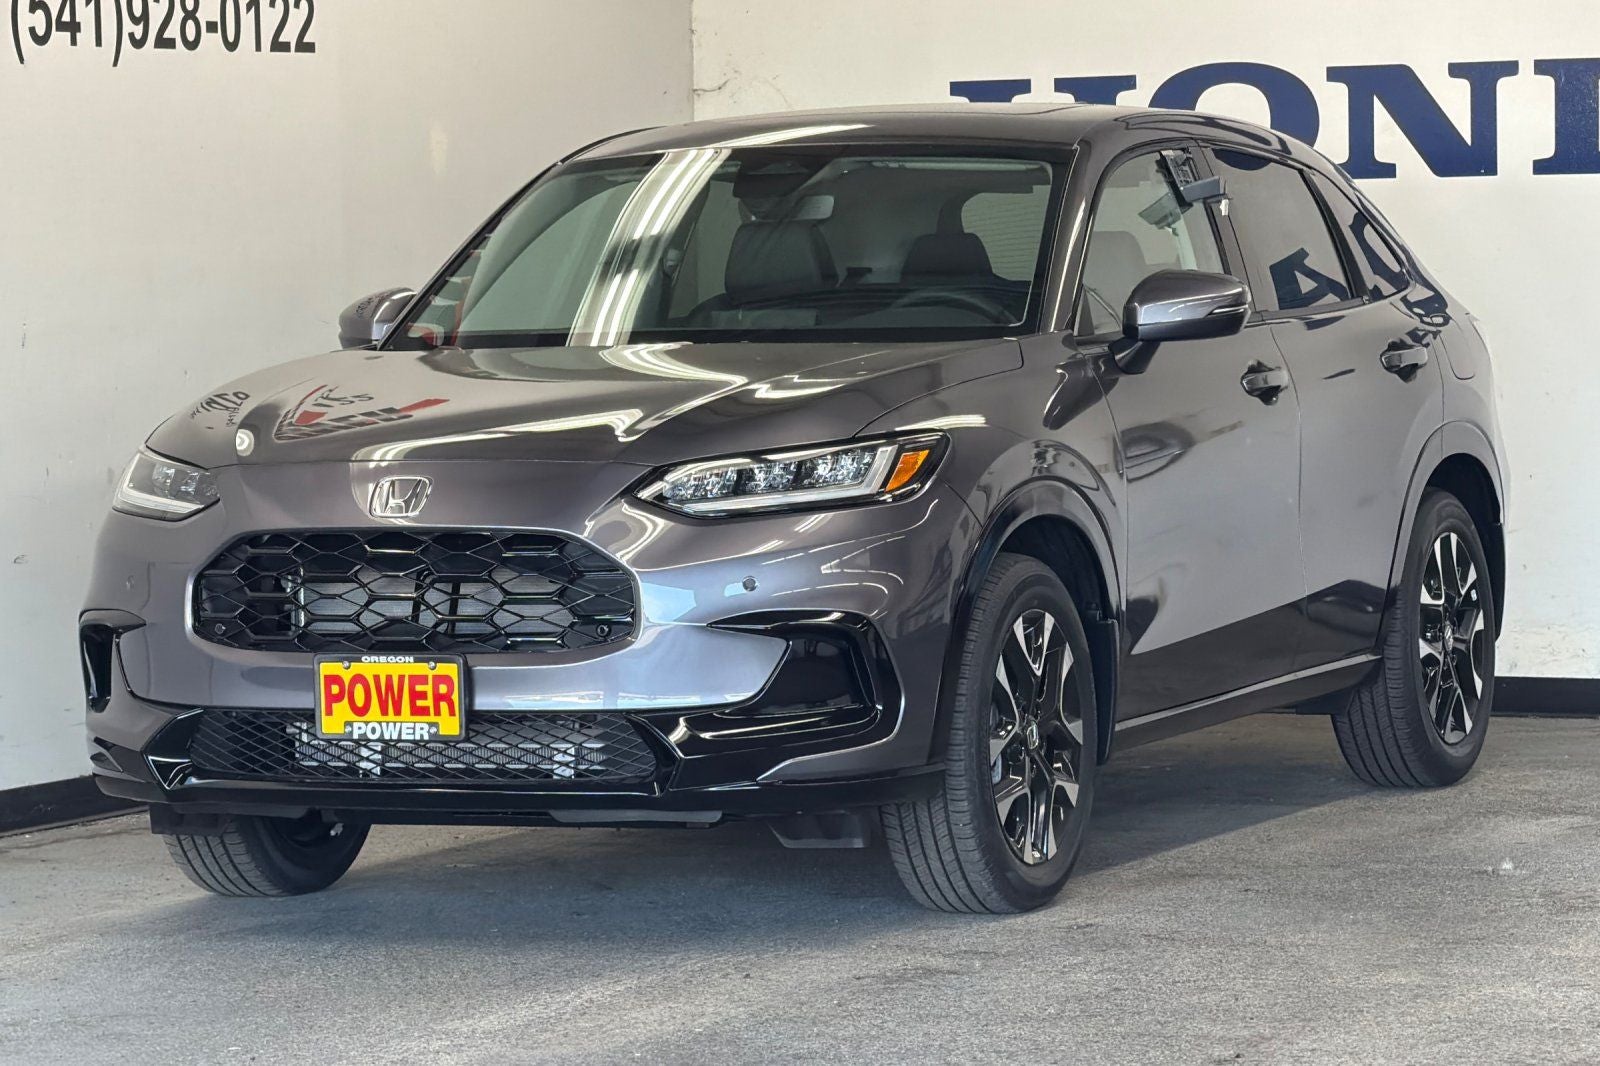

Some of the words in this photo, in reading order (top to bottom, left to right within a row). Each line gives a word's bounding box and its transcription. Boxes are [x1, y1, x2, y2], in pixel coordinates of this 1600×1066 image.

[10, 0, 316, 67] (541)928-0122
[361, 655, 414, 663] OREGON
[323, 673, 457, 717] POWER
[352, 721, 429, 740] POWER
